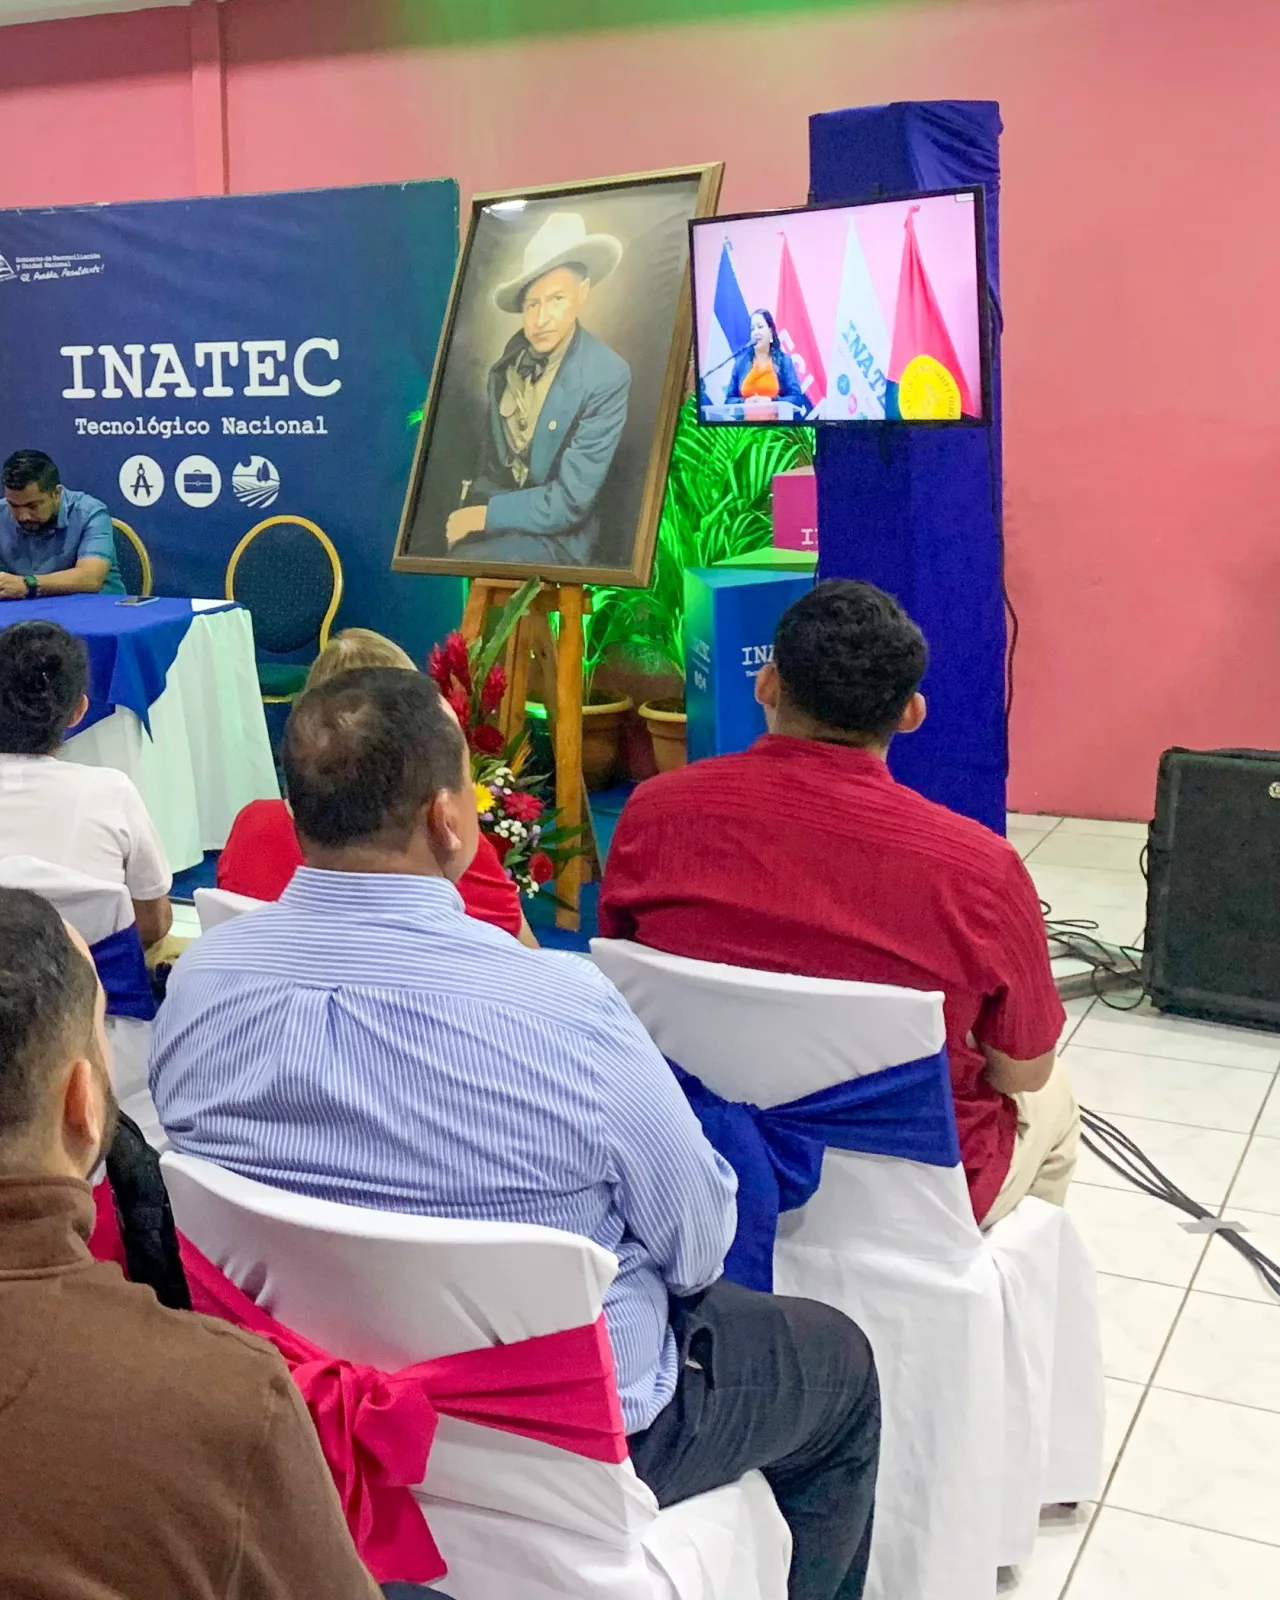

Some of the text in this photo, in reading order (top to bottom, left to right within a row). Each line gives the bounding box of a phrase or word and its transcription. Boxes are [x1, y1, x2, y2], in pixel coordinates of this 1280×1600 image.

[60, 337, 342, 399] INATEC
[75, 415, 328, 439] Tecnológico Nacional
